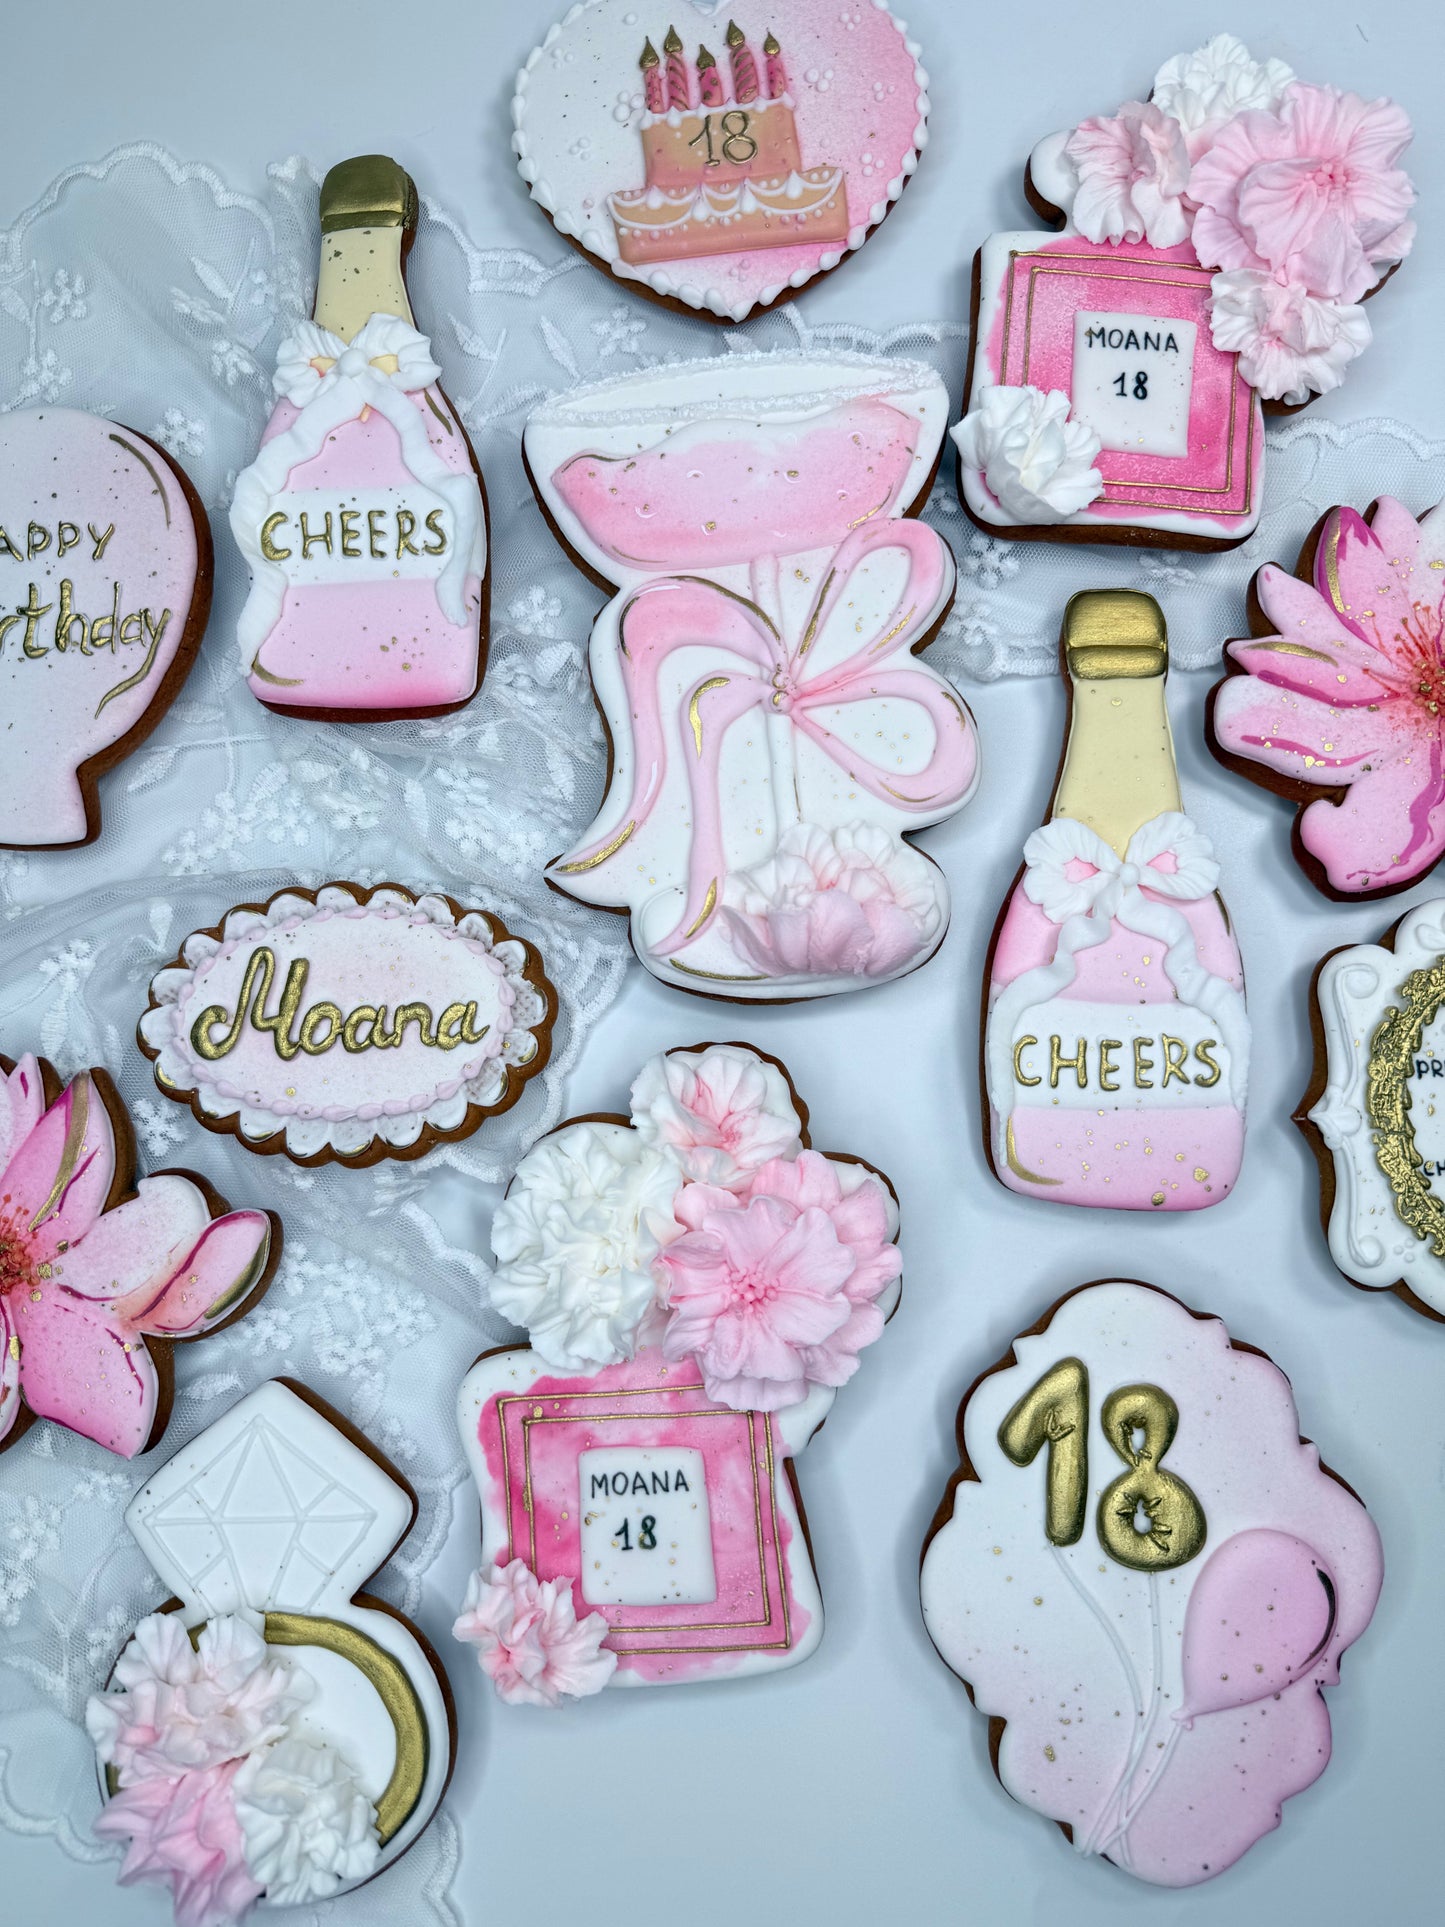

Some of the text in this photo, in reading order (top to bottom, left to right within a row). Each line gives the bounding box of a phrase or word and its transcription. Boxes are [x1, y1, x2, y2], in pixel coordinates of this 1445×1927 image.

[689, 110, 758, 167] 18
[1087, 326, 1180, 354] MOANA
[1112, 371, 1149, 400] 18
[261, 509, 448, 561] CHEERS
[190, 946, 490, 1061] Moana
[1012, 1033, 1221, 1091] CHEERS
[591, 1468, 690, 1499] MOANA
[997, 1356, 1207, 1572] 18
[614, 1514, 657, 1551] 18
